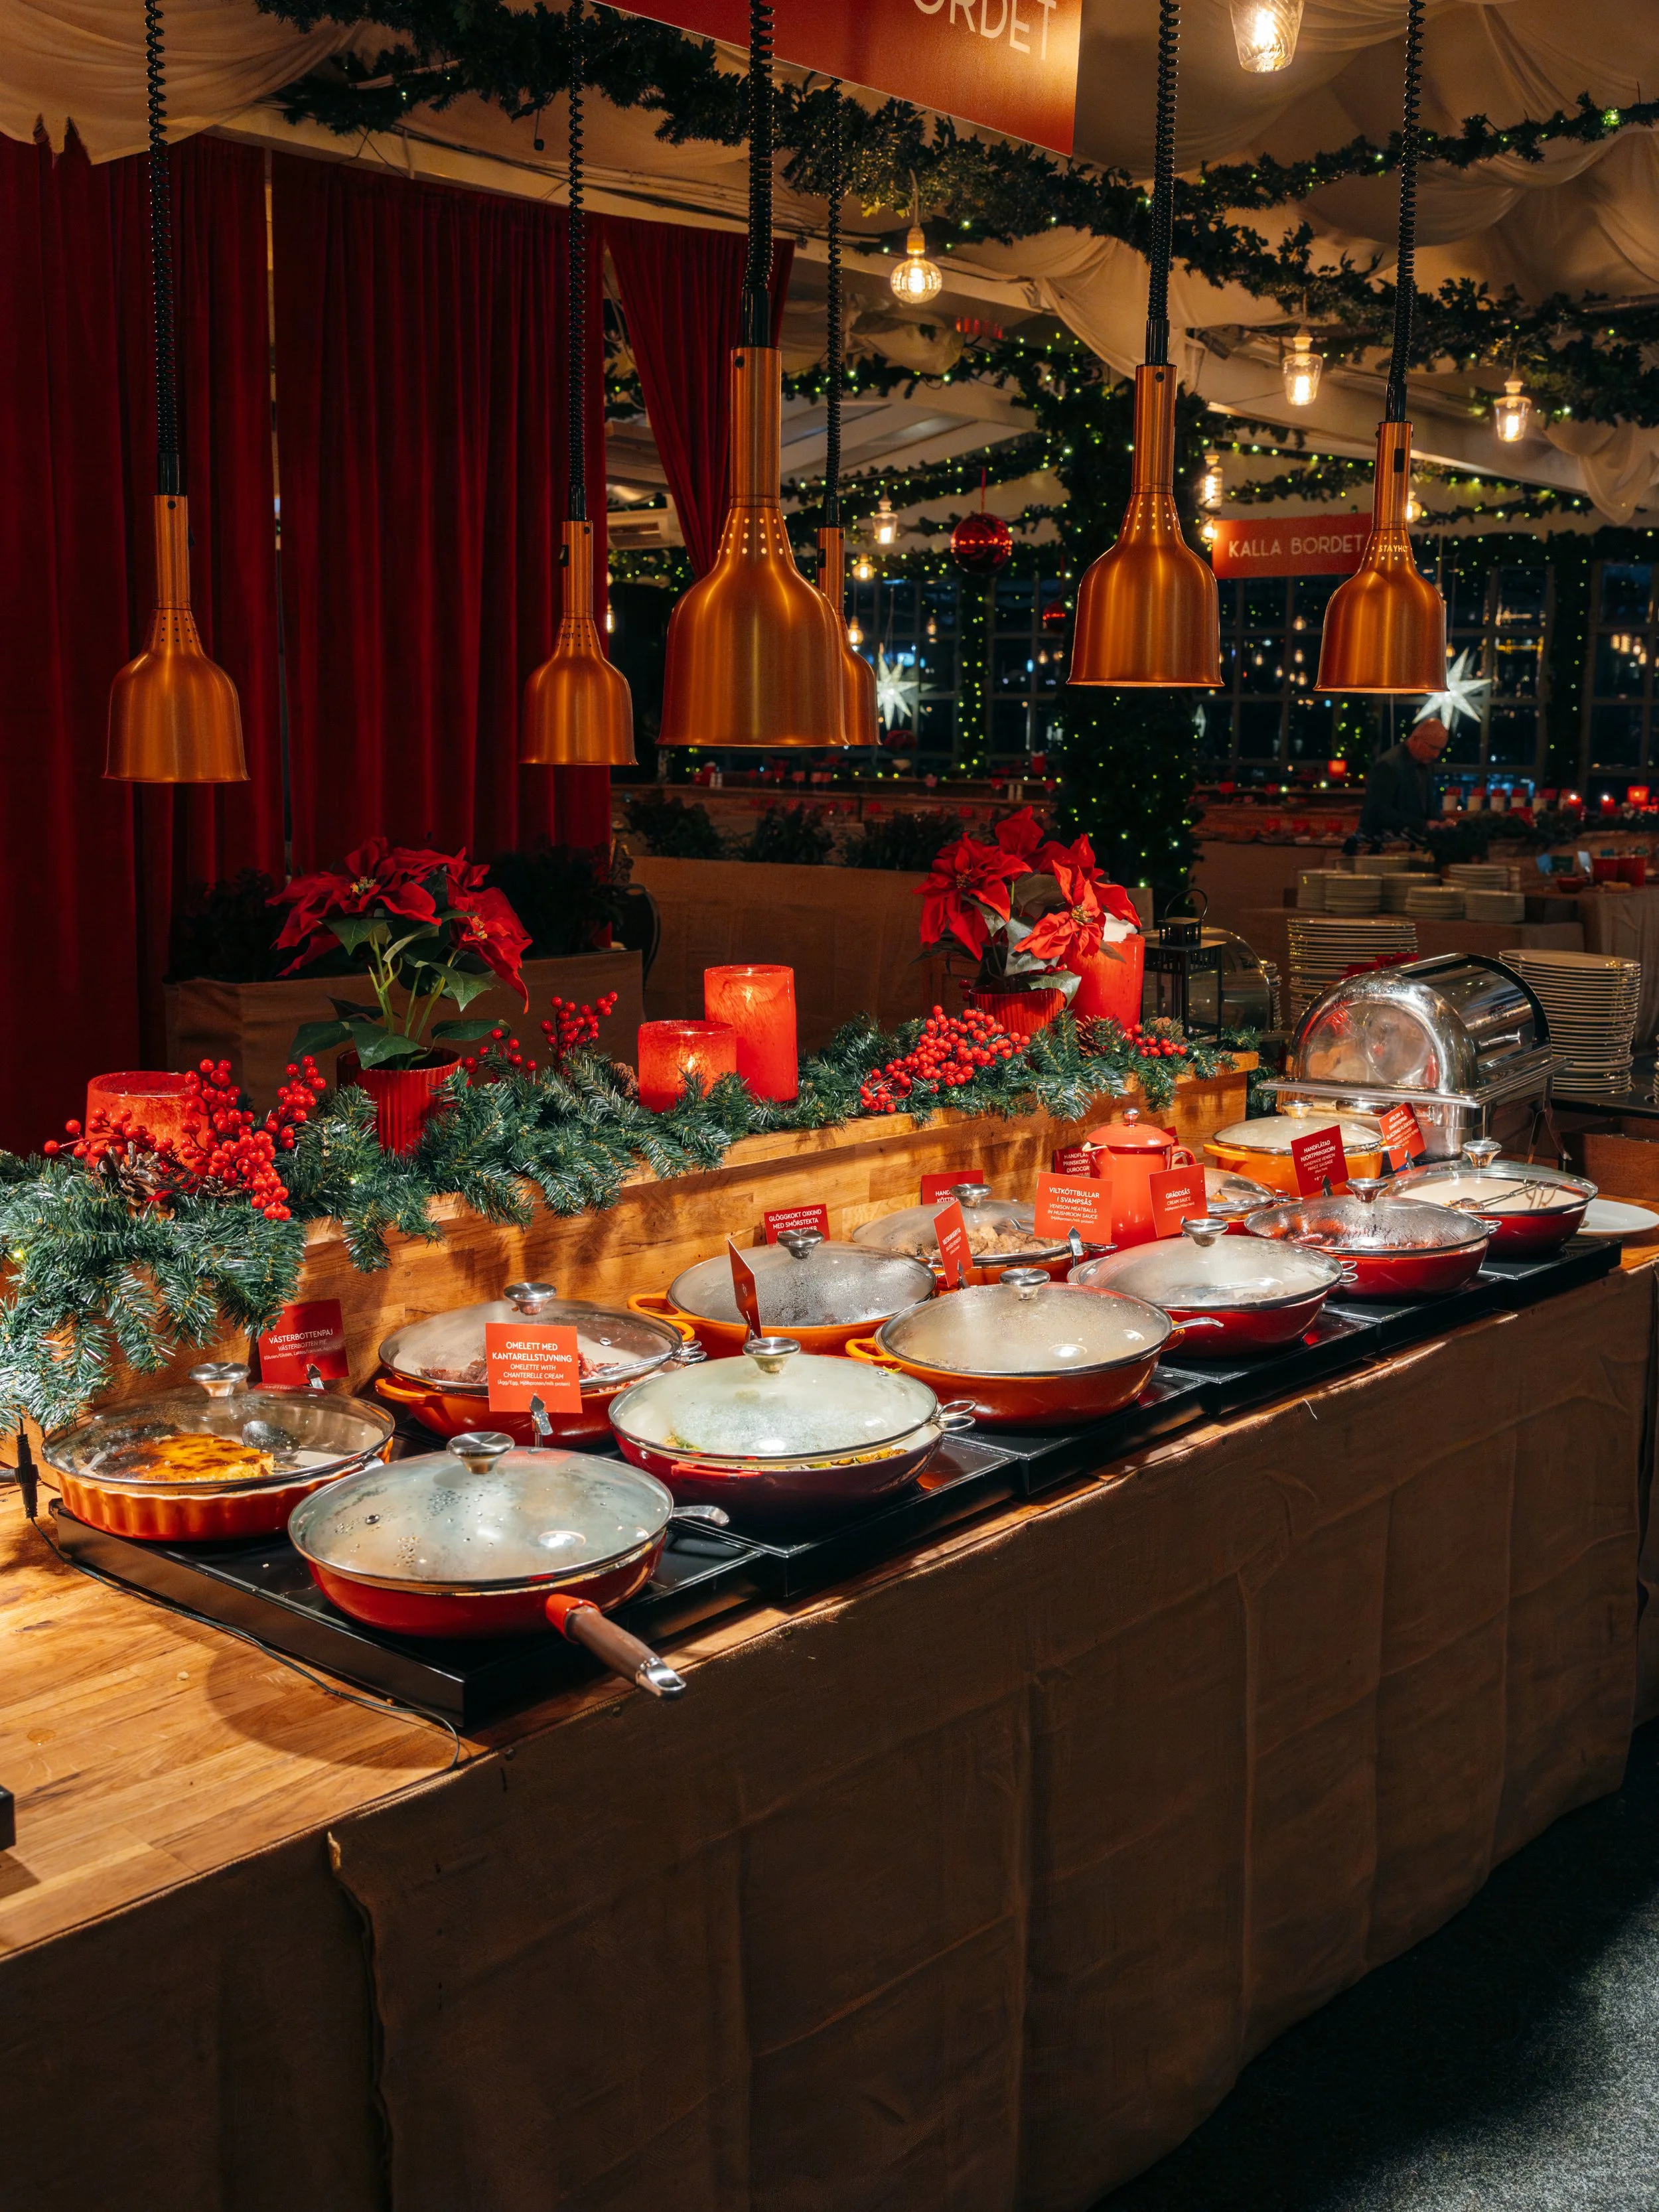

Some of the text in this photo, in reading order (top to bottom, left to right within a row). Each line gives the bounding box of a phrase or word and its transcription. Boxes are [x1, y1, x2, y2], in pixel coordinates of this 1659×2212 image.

[1228, 534, 1364, 559] KALLA BORDET
[1303, 1140, 1331, 1153] HANDFLÄTAD
[1301, 1145, 1336, 1162] HJORTPRINSKORV
[1048, 1186, 1100, 1199] VILTKÖTTBULLAR
[1165, 1187, 1190, 1199] GRÄDDSÅS
[1060, 1197, 1092, 1206] SVAMPSÅS
[768, 1209, 822, 1222] GLÖGGKOKT OXKIND
[1070, 1205, 1098, 1214] MEATBALLS
[785, 1218, 819, 1228] SMÖRSTEKTA
[268, 1328, 333, 1345] VÄSTERBOTTENPAJ
[277, 1341, 319, 1352] VÄSTERBOTTEN
[506, 1341, 558, 1351] OMELETT MED
[492, 1352, 573, 1363] KANTARELLSTUVNING
